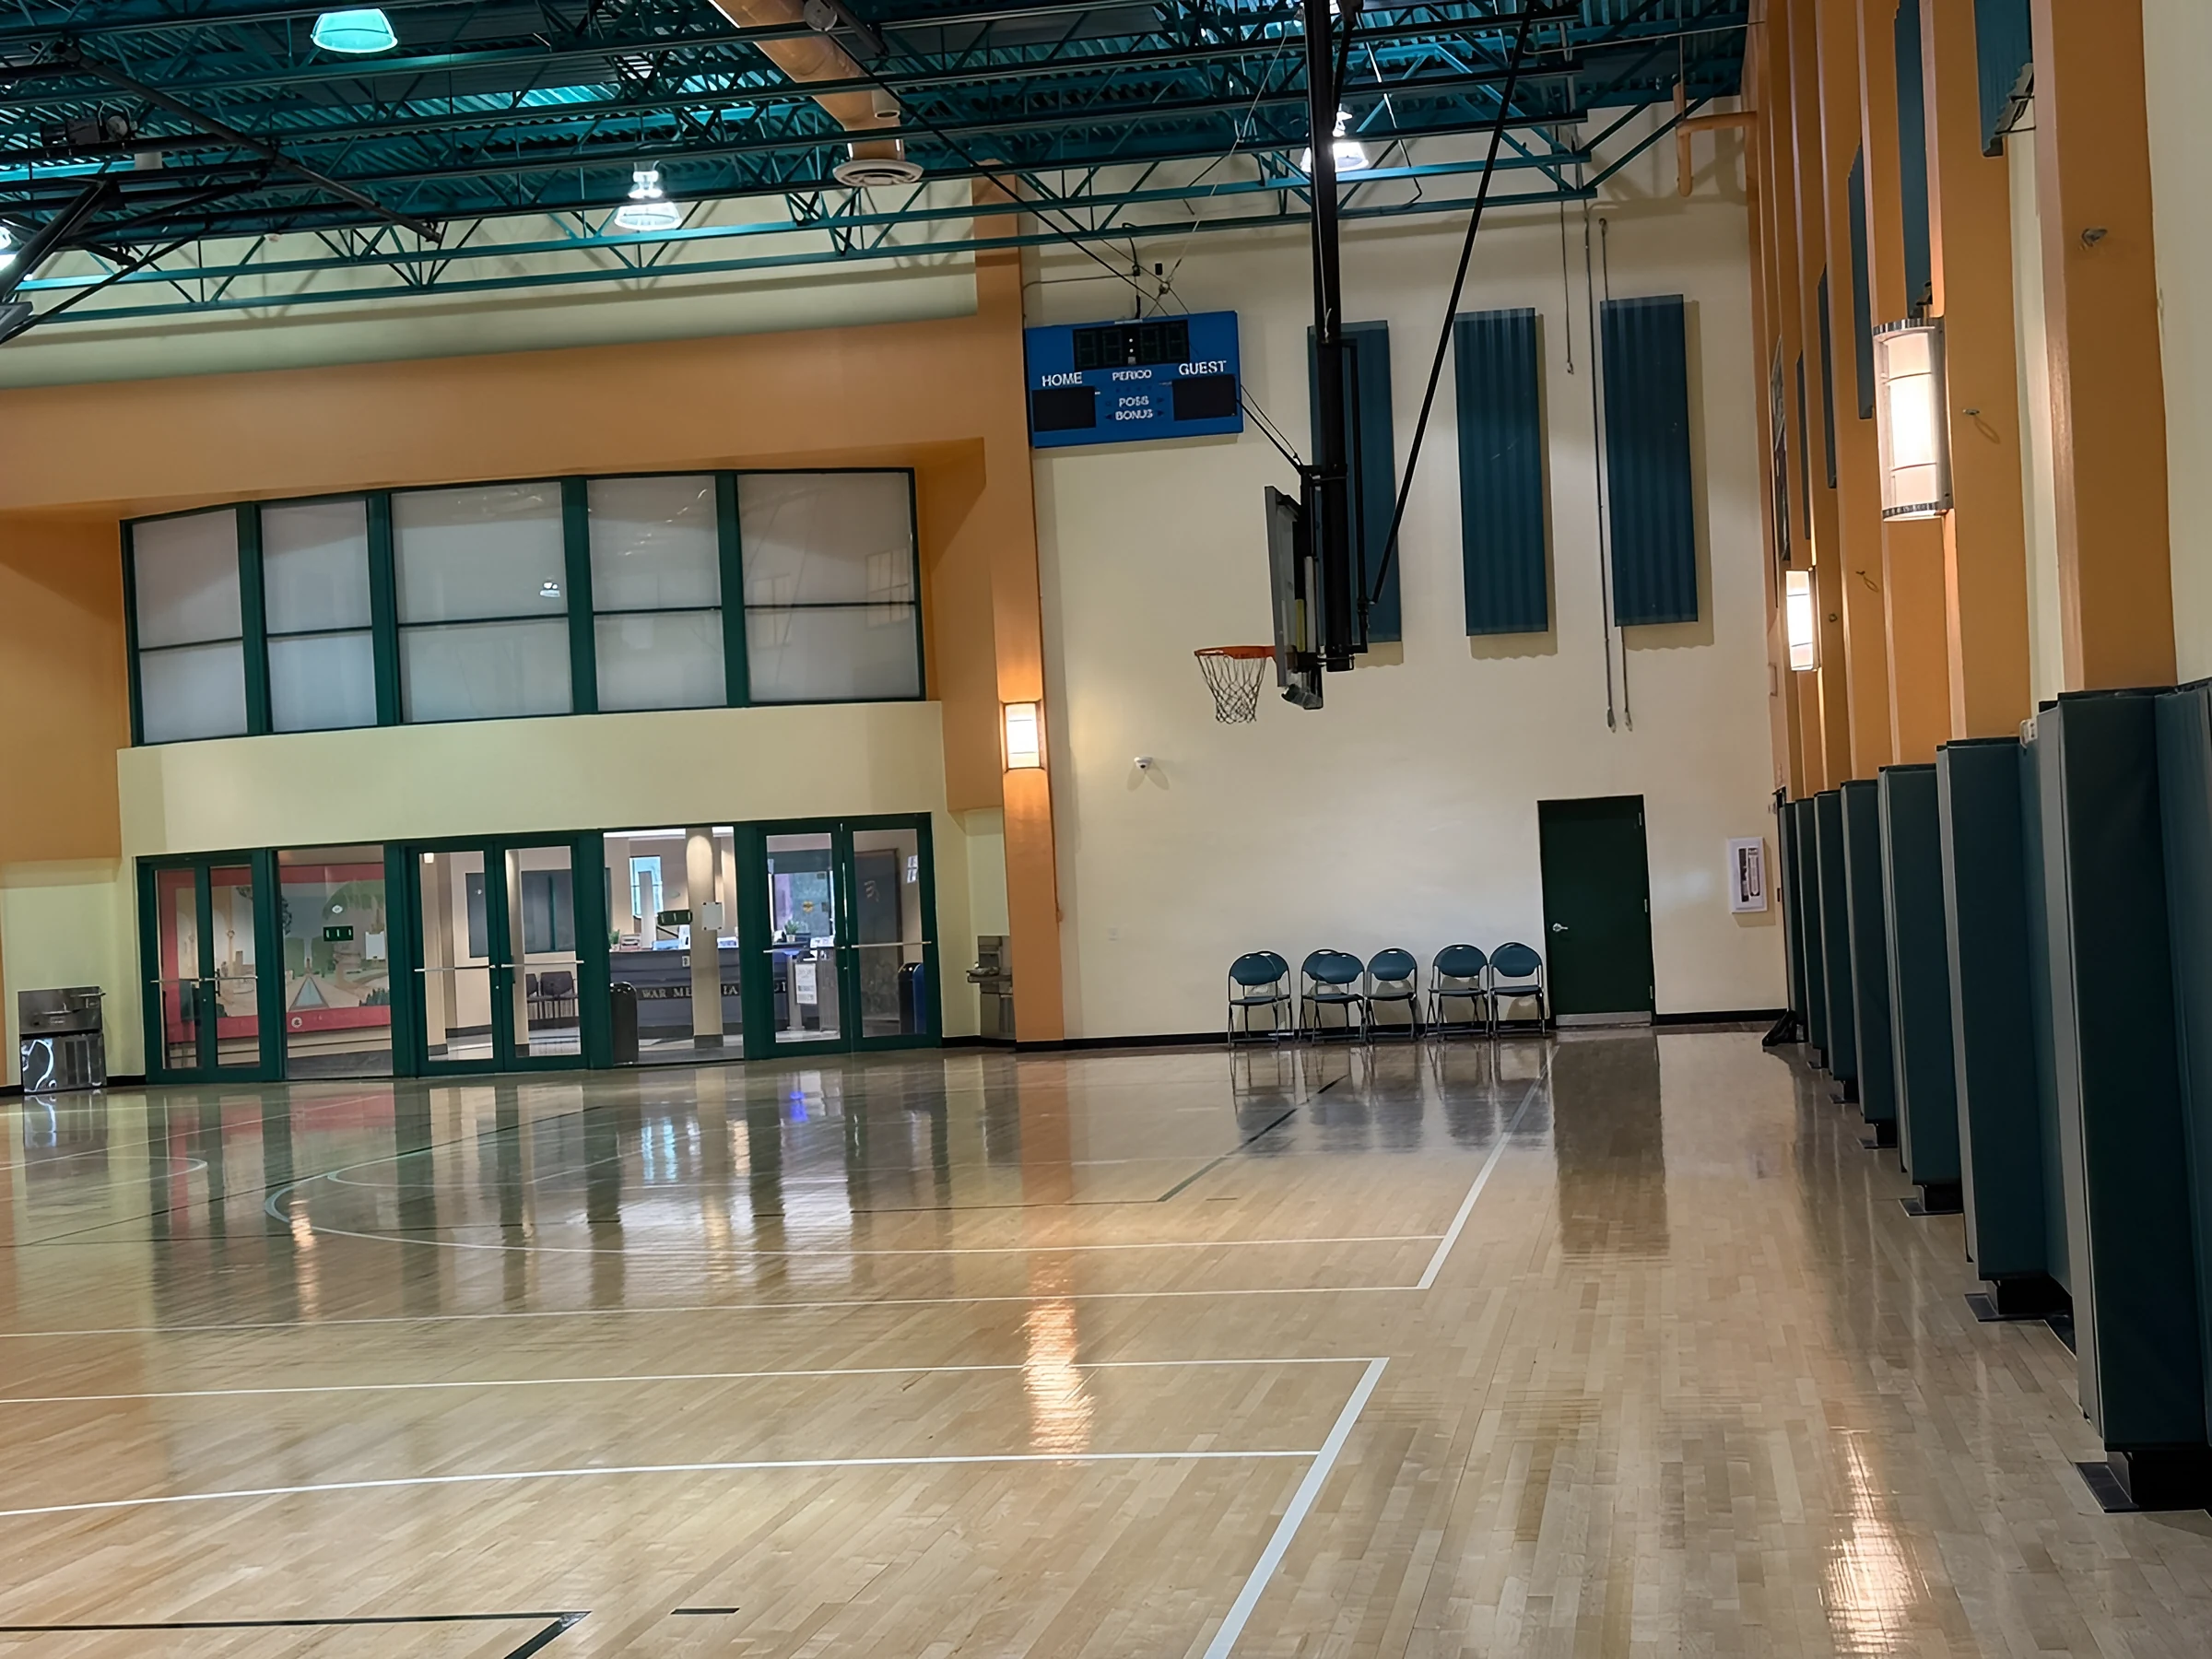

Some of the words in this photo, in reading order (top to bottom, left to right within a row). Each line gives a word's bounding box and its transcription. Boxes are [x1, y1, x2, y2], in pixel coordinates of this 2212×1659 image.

[1179, 360, 1227, 376] GUEST
[1041, 371, 1083, 387] HOME
[1115, 408, 1153, 420] BONUS
[642, 988, 667, 998] WAR
